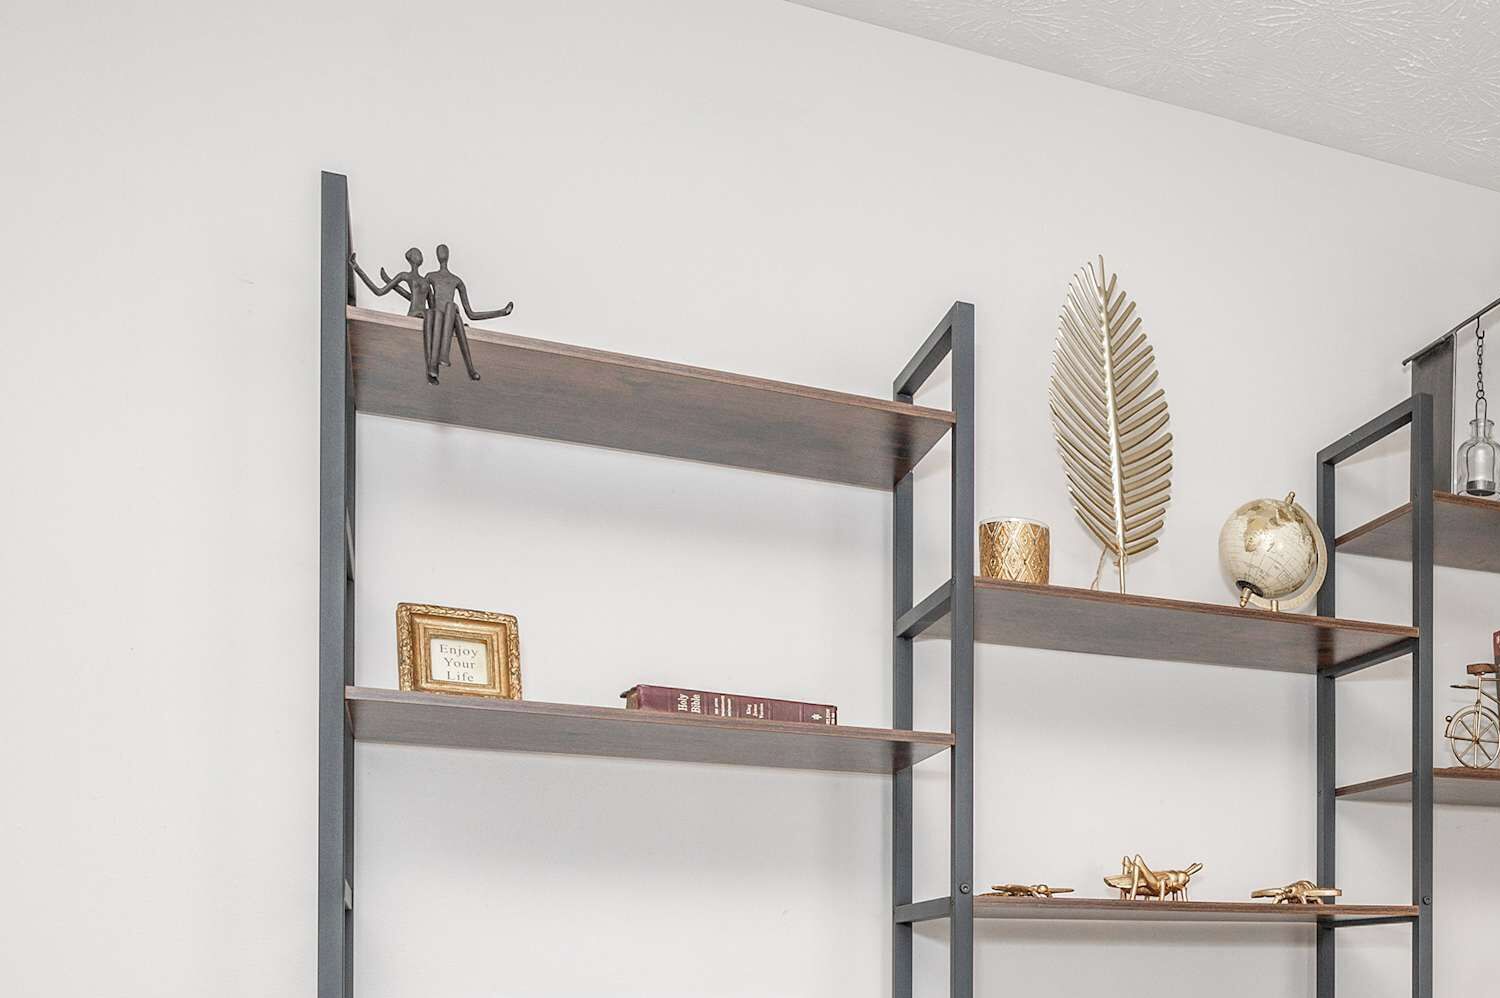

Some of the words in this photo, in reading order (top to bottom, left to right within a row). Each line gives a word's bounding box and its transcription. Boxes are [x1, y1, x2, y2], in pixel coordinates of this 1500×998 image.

[440, 644, 478, 659] Enjoy
[444, 657, 475, 669] Your
[447, 671, 474, 682] Life
[678, 693, 689, 712] Holy
[691, 694, 701, 714] Bible
